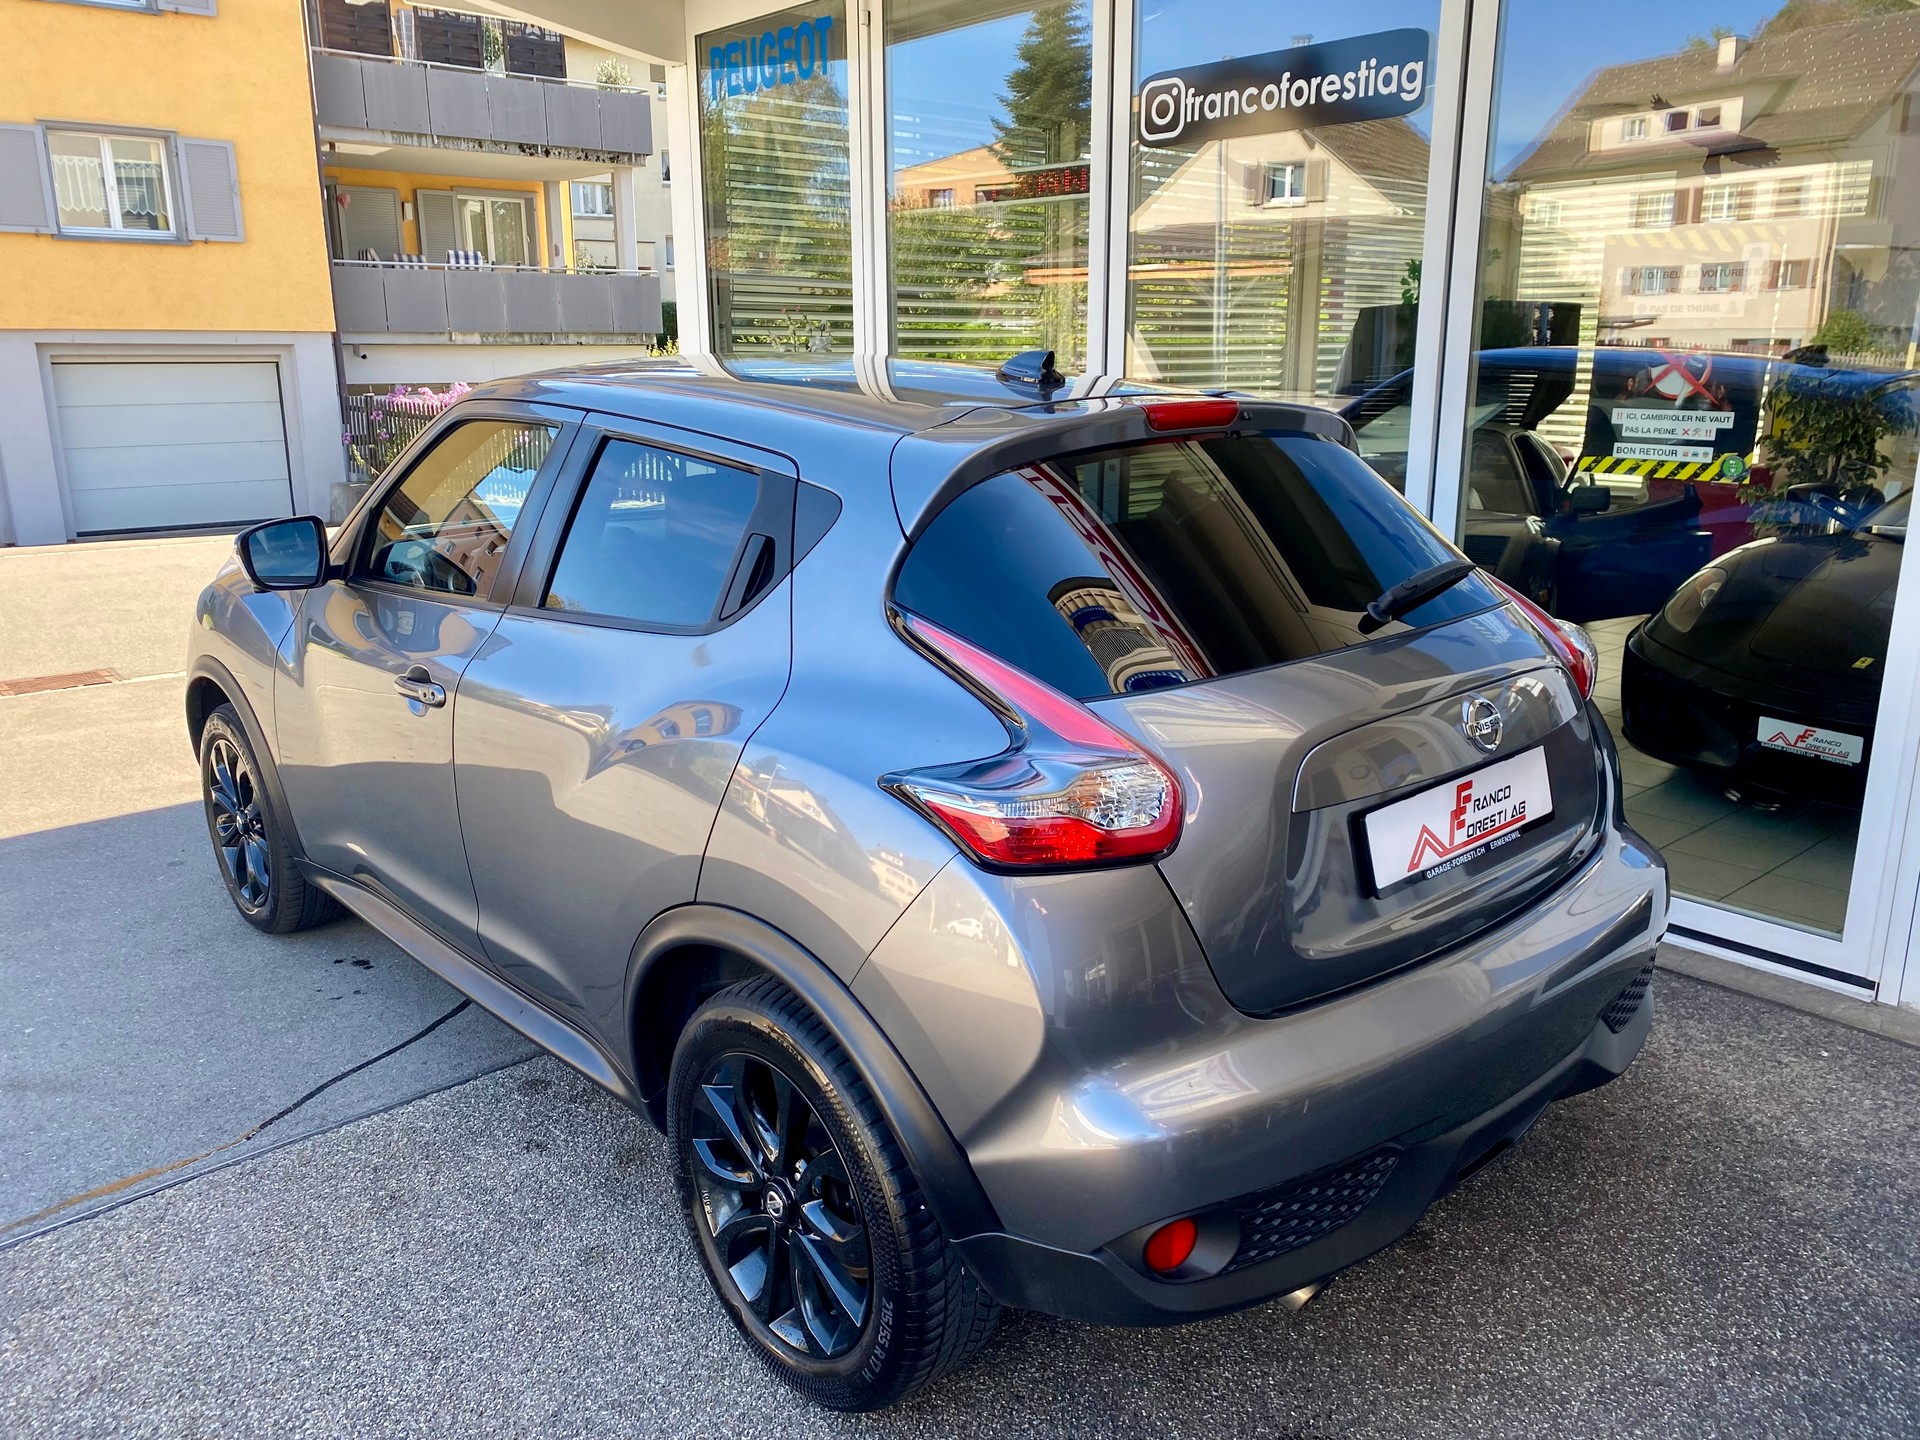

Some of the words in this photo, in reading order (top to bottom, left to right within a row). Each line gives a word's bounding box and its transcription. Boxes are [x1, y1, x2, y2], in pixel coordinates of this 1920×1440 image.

[709, 16, 832, 101] PEUGEOT
[1185, 57, 1424, 123] francoforestiag
[1626, 413, 1639, 421] ICI,
[1640, 413, 1693, 422] CAMBRIOLER
[1695, 415, 1707, 423] NE
[1709, 415, 1732, 424] VAUT
[1625, 426, 1639, 434] PAS
[1653, 427, 1679, 436] PEINE.
[1616, 446, 1636, 455] BON
[1639, 446, 1678, 458] RETOUR
[1510, 801, 1526, 819] AG
[1426, 847, 1486, 879] GARAGE-FORESTI.CH
[1490, 830, 1521, 850] ERMENSWIL
[877, 1296, 894, 1349] 215/55
[861, 1367, 875, 1383] H
